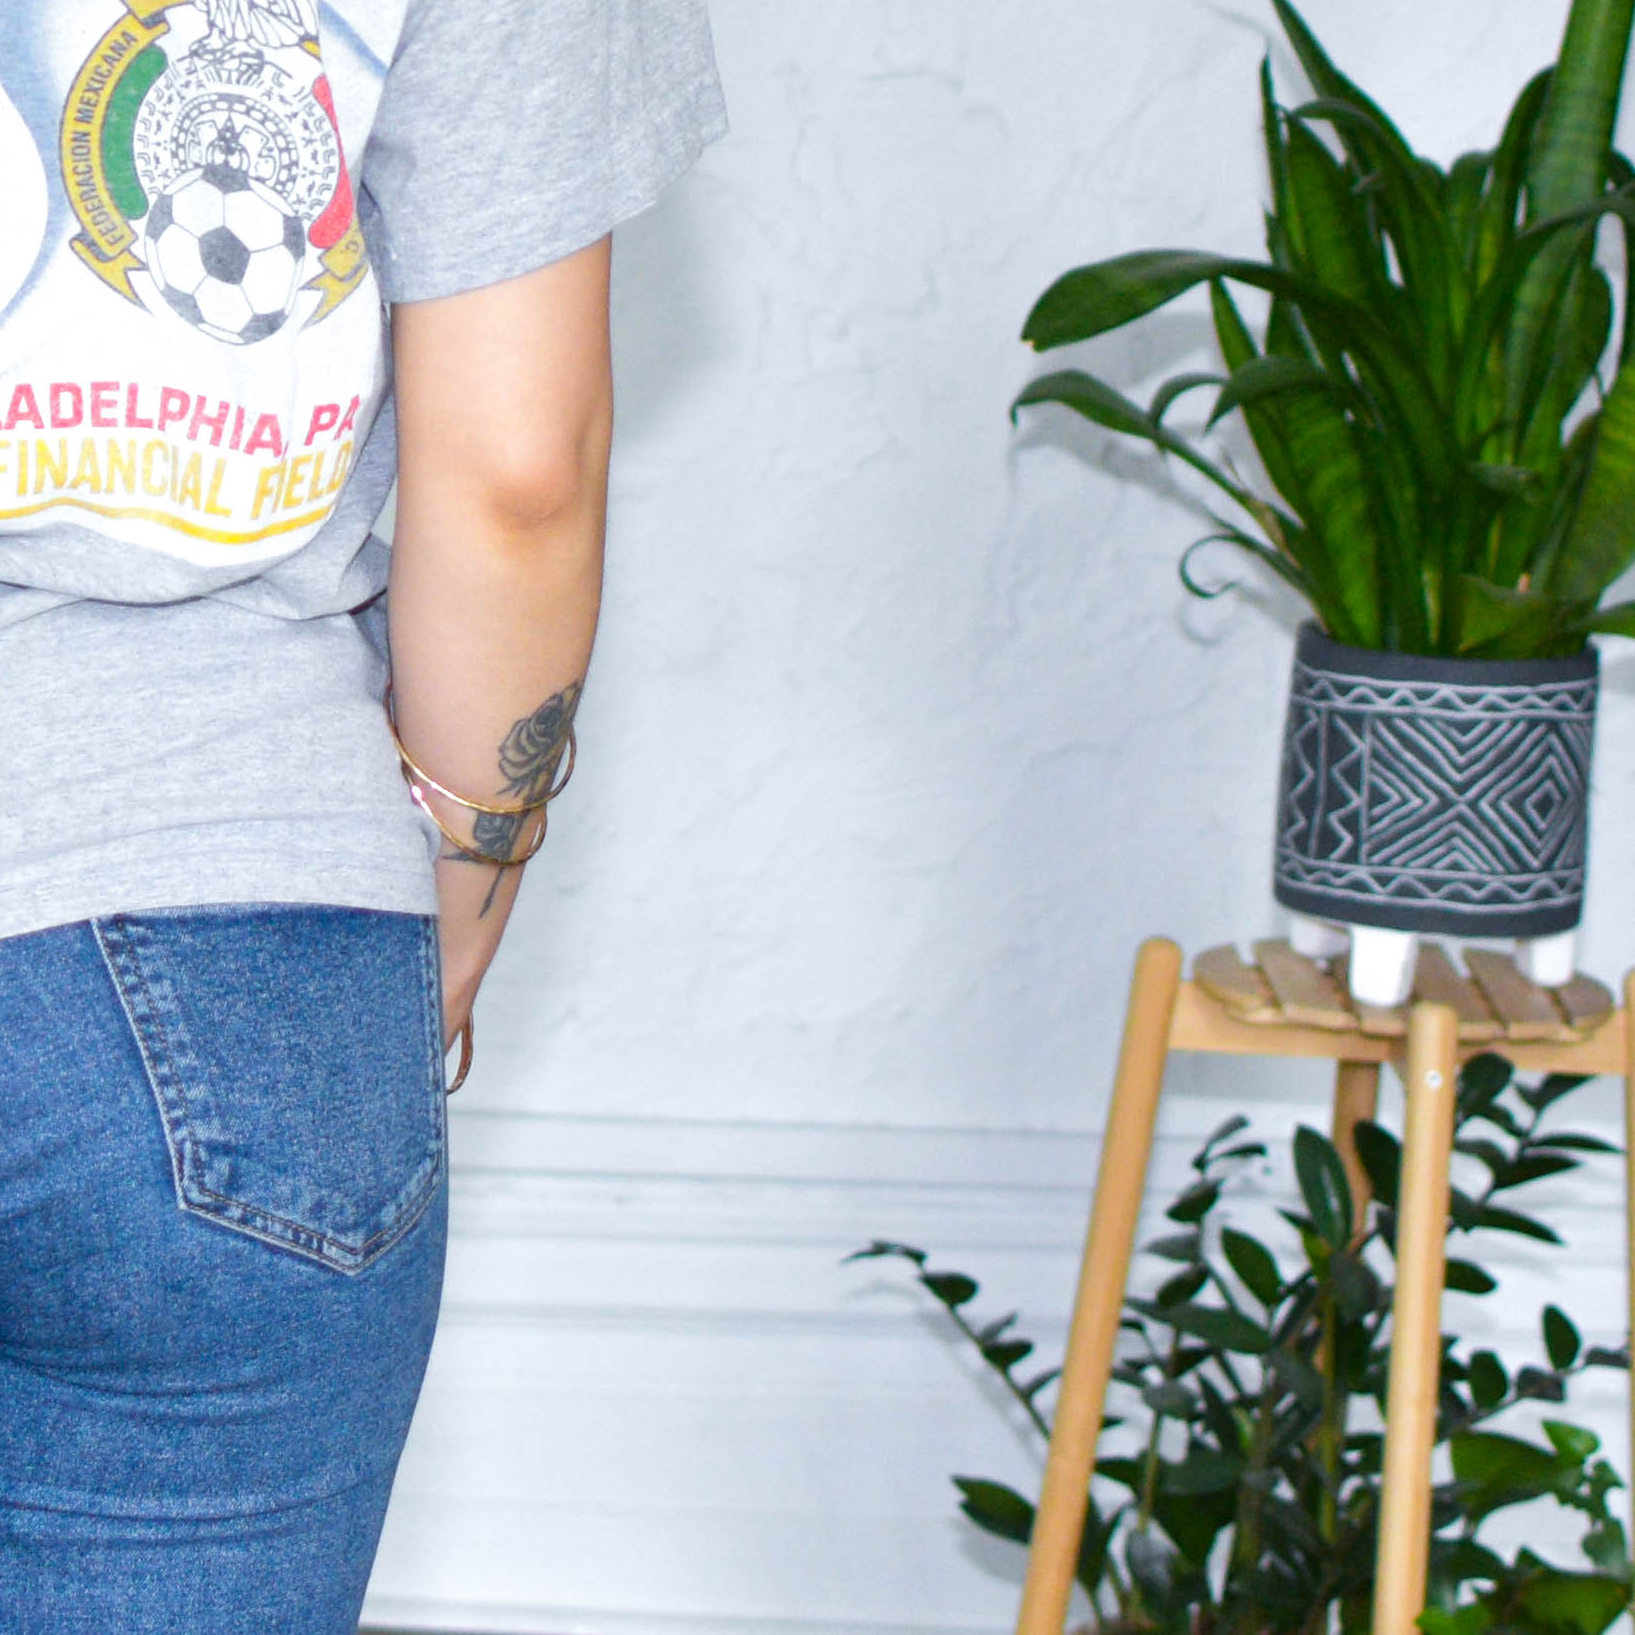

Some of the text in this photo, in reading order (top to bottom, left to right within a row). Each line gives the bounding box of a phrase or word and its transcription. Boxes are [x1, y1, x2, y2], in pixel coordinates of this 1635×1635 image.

[71, 29, 139, 247] FEDERACION MEXICANA
[304, 393, 360, 446] PA
